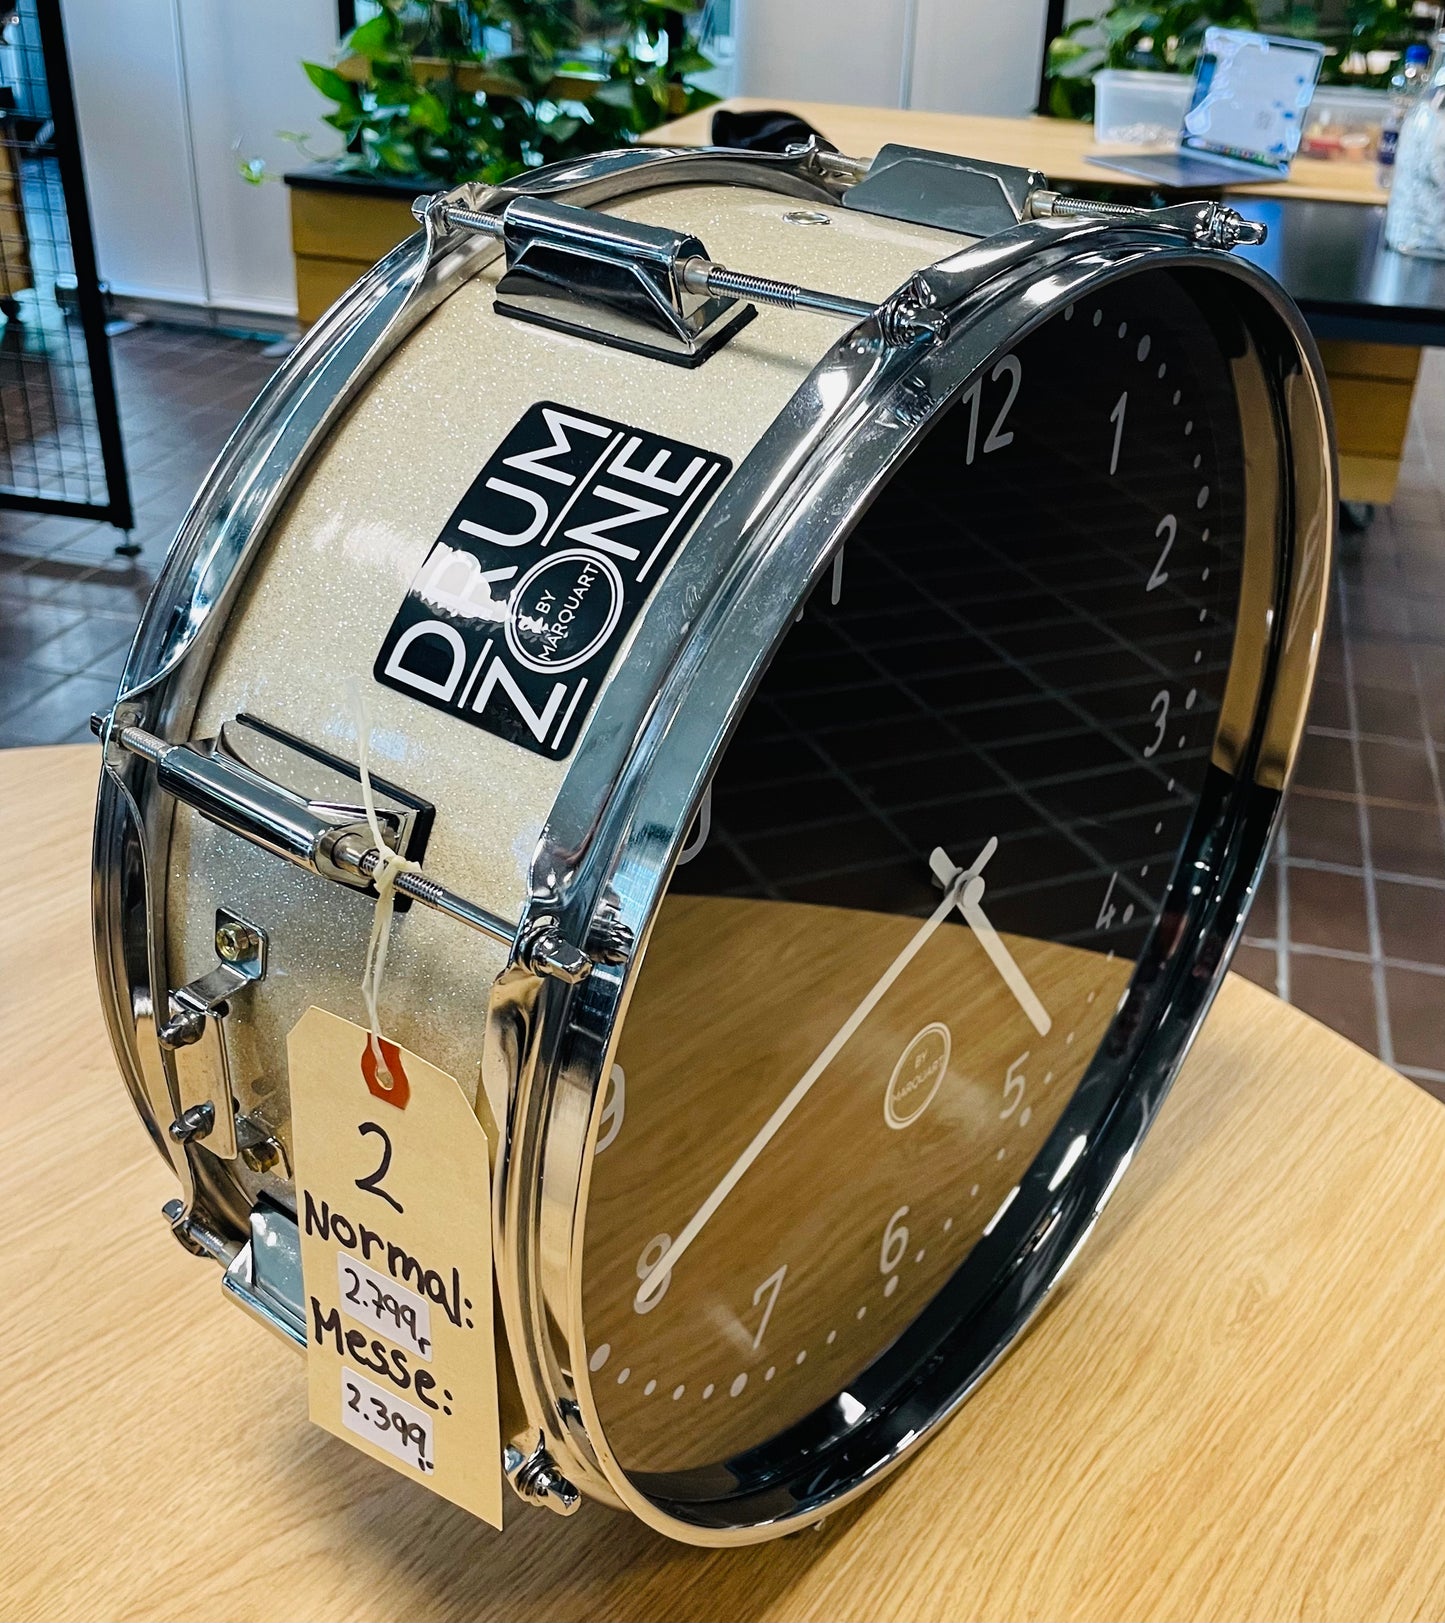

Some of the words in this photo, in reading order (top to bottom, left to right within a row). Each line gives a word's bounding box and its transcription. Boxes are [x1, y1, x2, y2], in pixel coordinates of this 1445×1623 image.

[962, 354, 1022, 465] 12
[1110, 391, 1128, 475] 1
[384, 408, 613, 702] DRUM
[472, 436, 706, 743] ZONE
[1146, 514, 1177, 592] 2
[535, 589, 556, 614] BY
[538, 563, 599, 661] MARQUART
[1143, 690, 1170, 757] 3
[1096, 871, 1118, 929] 4
[1000, 1051, 1030, 1119] 5
[355, 1121, 404, 1214] 2
[303, 1189, 474, 1328] Normal:
[633, 1233, 672, 1314] 8
[880, 1205, 910, 1274] 6
[753, 1264, 788, 1350] 7
[310, 1296, 453, 1415] Messe:
